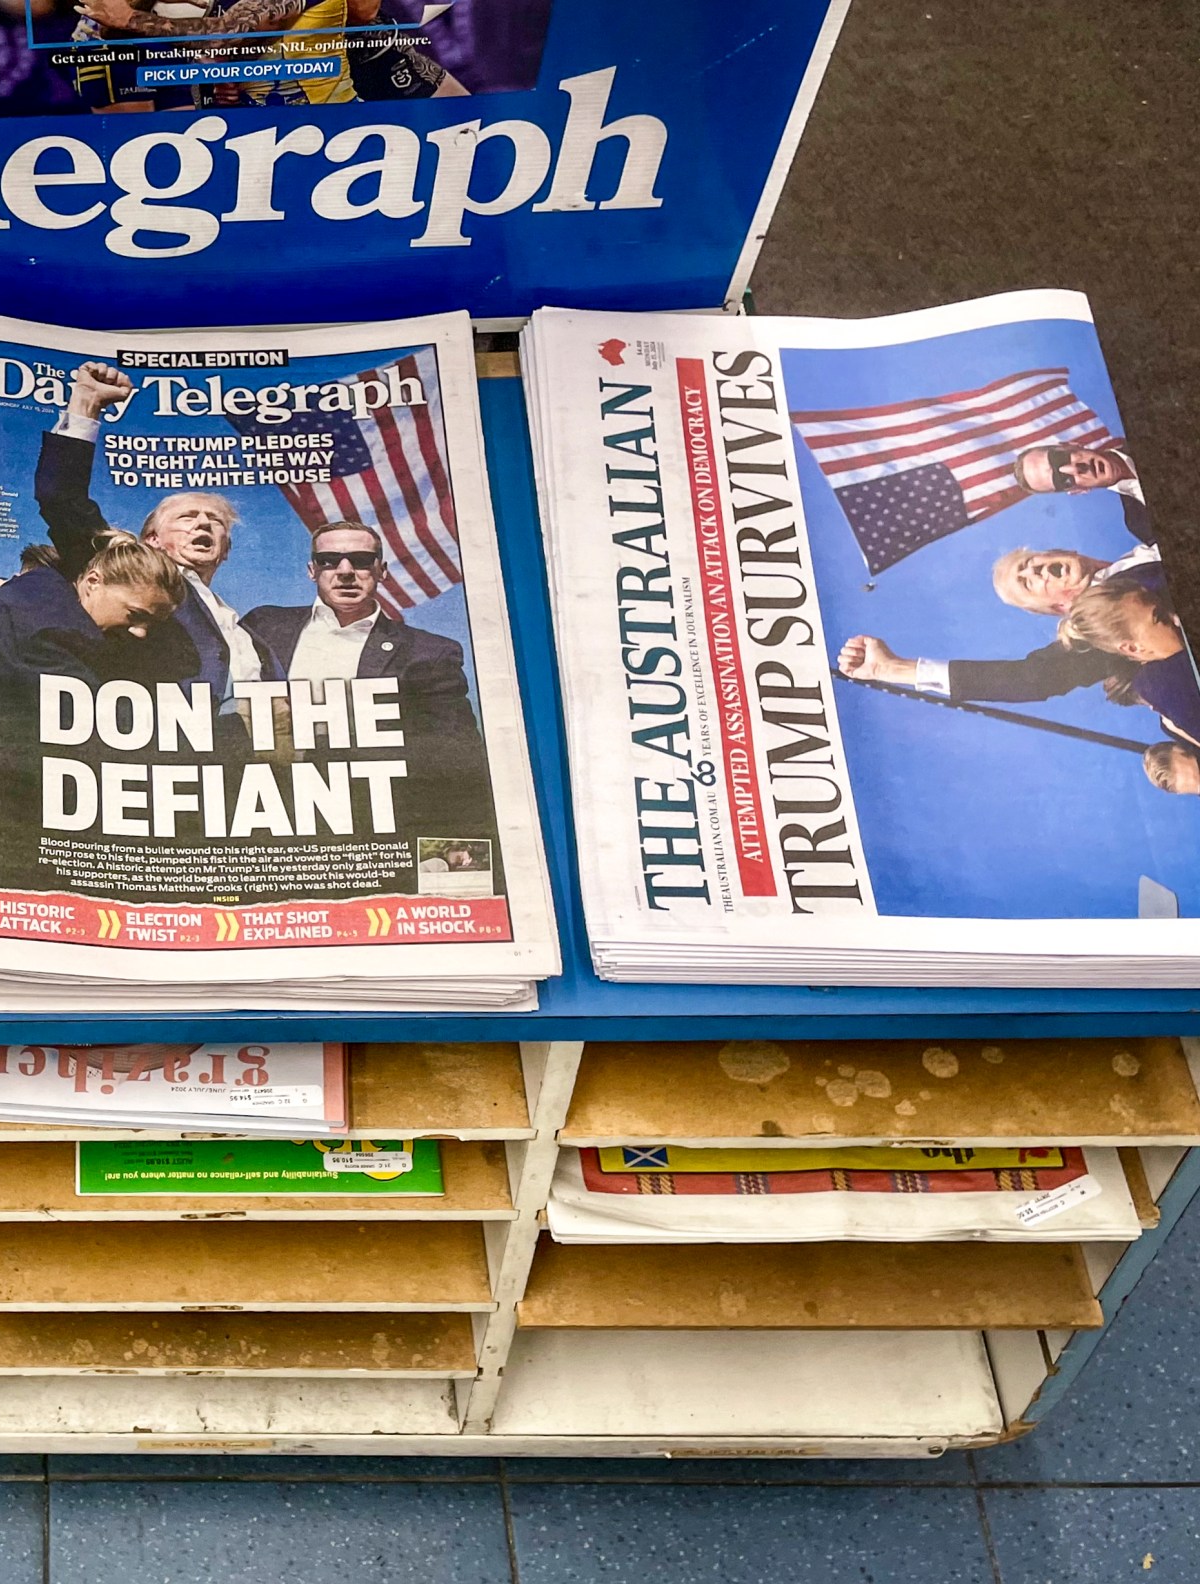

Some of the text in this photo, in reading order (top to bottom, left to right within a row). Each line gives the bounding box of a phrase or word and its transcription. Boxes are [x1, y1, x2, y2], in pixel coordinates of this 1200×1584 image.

[52, 36, 432, 64] Get a read on breaking sport news, NRL, opinion and more.
[144, 62, 334, 81] PICK UP YOUR COPY TODAY!
[121, 350, 286, 368] SPECIAL EDITION
[33, 361, 66, 379] The
[142, 368, 428, 424] Telegraph
[104, 433, 334, 451] SHOT TRUMP PLEDGES
[104, 450, 335, 469] TO FIGHT ALL THE WAY
[110, 467, 331, 488] TO THE WHITE HOUSE
[684, 386, 764, 862] ATTEMPTED ASSASSINATION AN ATTACK ON DEMOCRACY
[711, 350, 863, 915] TRUMP SURVIVES
[598, 376, 711, 911] THE AUSTRALIAN
[38, 672, 406, 752] DON THE
[682, 576, 734, 913] THEAUSTRALIAN.COM.AU 60 YEARS OF EXCELLENCE IN JOURNALISM
[41, 756, 408, 838] DEFIANT
[70, 878, 382, 893] assassin Thomas Matthew Crooks (right) who was shot dead.
[213, 895, 240, 903] INSIDE
[0, 901, 75, 920] HISTORIC
[242, 910, 329, 926] THAT SHOT
[396, 905, 472, 920] A WORLD
[0, 916, 62, 934] ATTACK
[126, 912, 202, 927] ELECTION
[397, 920, 476, 935] IN SHOCK
[126, 928, 177, 942] TWIST
[243, 926, 333, 941] EXPLAINED
[188, 1086, 226, 1094] JUNE/JULY
[229, 1094, 252, 1102] $14.95
[332, 1156, 353, 1164] $10.95
[104, 1173, 121, 1181] are!
[122, 1173, 138, 1181] you
[140, 1172, 165, 1180] where
[209, 1170, 261, 1180] self-reliance
[263, 1171, 279, 1179] and
[281, 1169, 339, 1181] Sustainability
